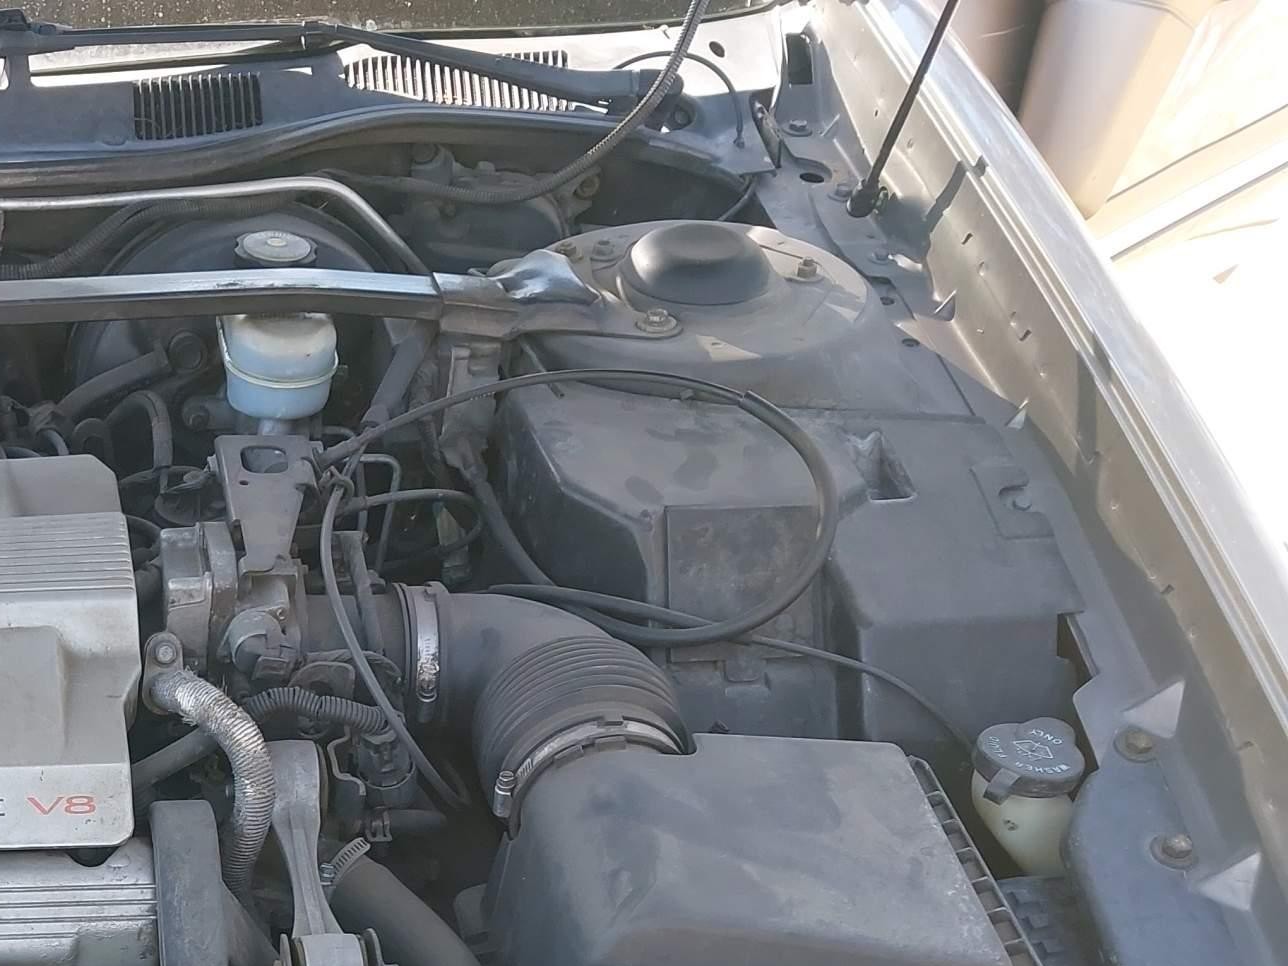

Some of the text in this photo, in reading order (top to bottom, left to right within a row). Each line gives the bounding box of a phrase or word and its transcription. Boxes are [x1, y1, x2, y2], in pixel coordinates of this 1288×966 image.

[1031, 728, 1063, 745] ONLY
[1014, 761, 1071, 774] WASHER
[26, 795, 97, 816] V8
